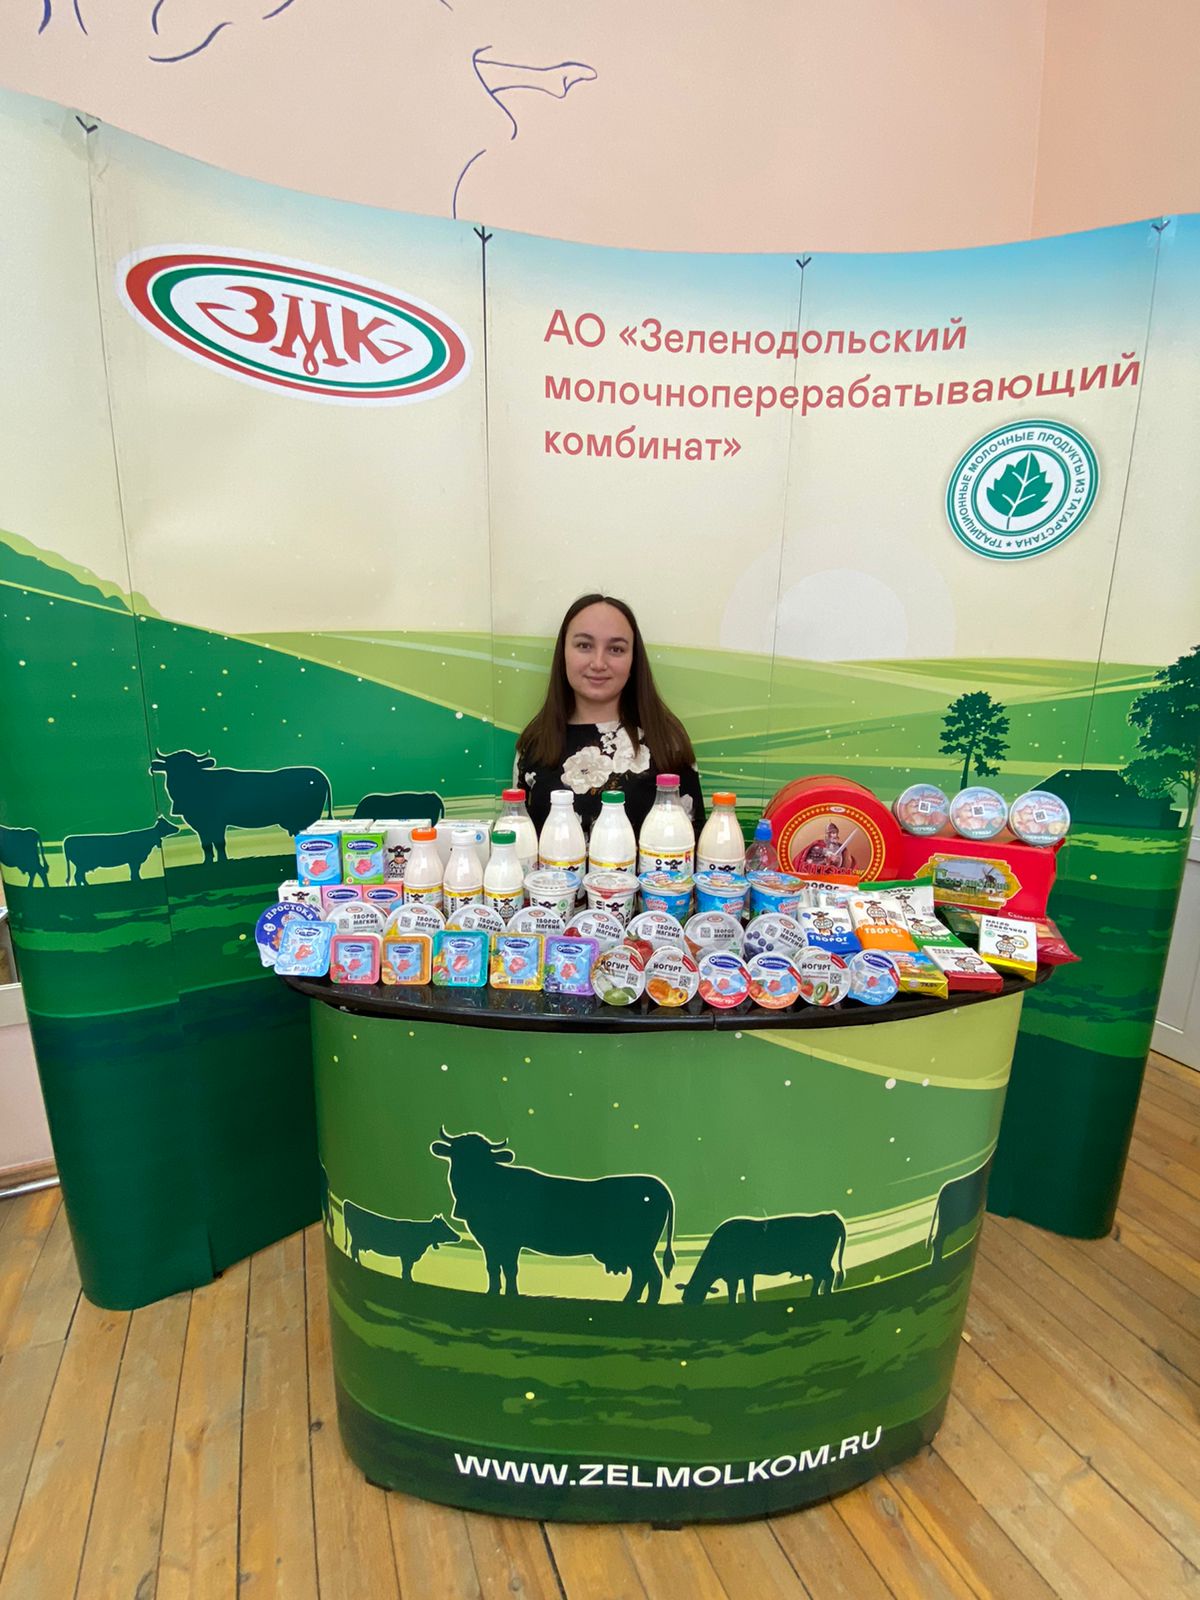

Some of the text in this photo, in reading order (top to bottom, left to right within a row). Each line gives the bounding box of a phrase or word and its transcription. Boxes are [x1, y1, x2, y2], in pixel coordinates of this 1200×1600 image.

[195, 285, 413, 376] ЗМК
[544, 309, 968, 358] АО «Зеленодольский
[544, 352, 1140, 417] молочноперерабатывающий
[544, 426, 742, 461] комбинат»
[958, 431, 1085, 549] ТРАДИЦИОННЫЕ МОЛОЧНЫЕ ПРОДУКТЫ ИЗ ТАТАРСТАНА
[265, 904, 313, 920] ПРОСТОКВ
[810, 934, 848, 943] ТВОРОГ
[801, 962, 832, 971] ЙОГУРТ
[453, 1425, 883, 1488] WWW.ZELMOLKOM.RU
